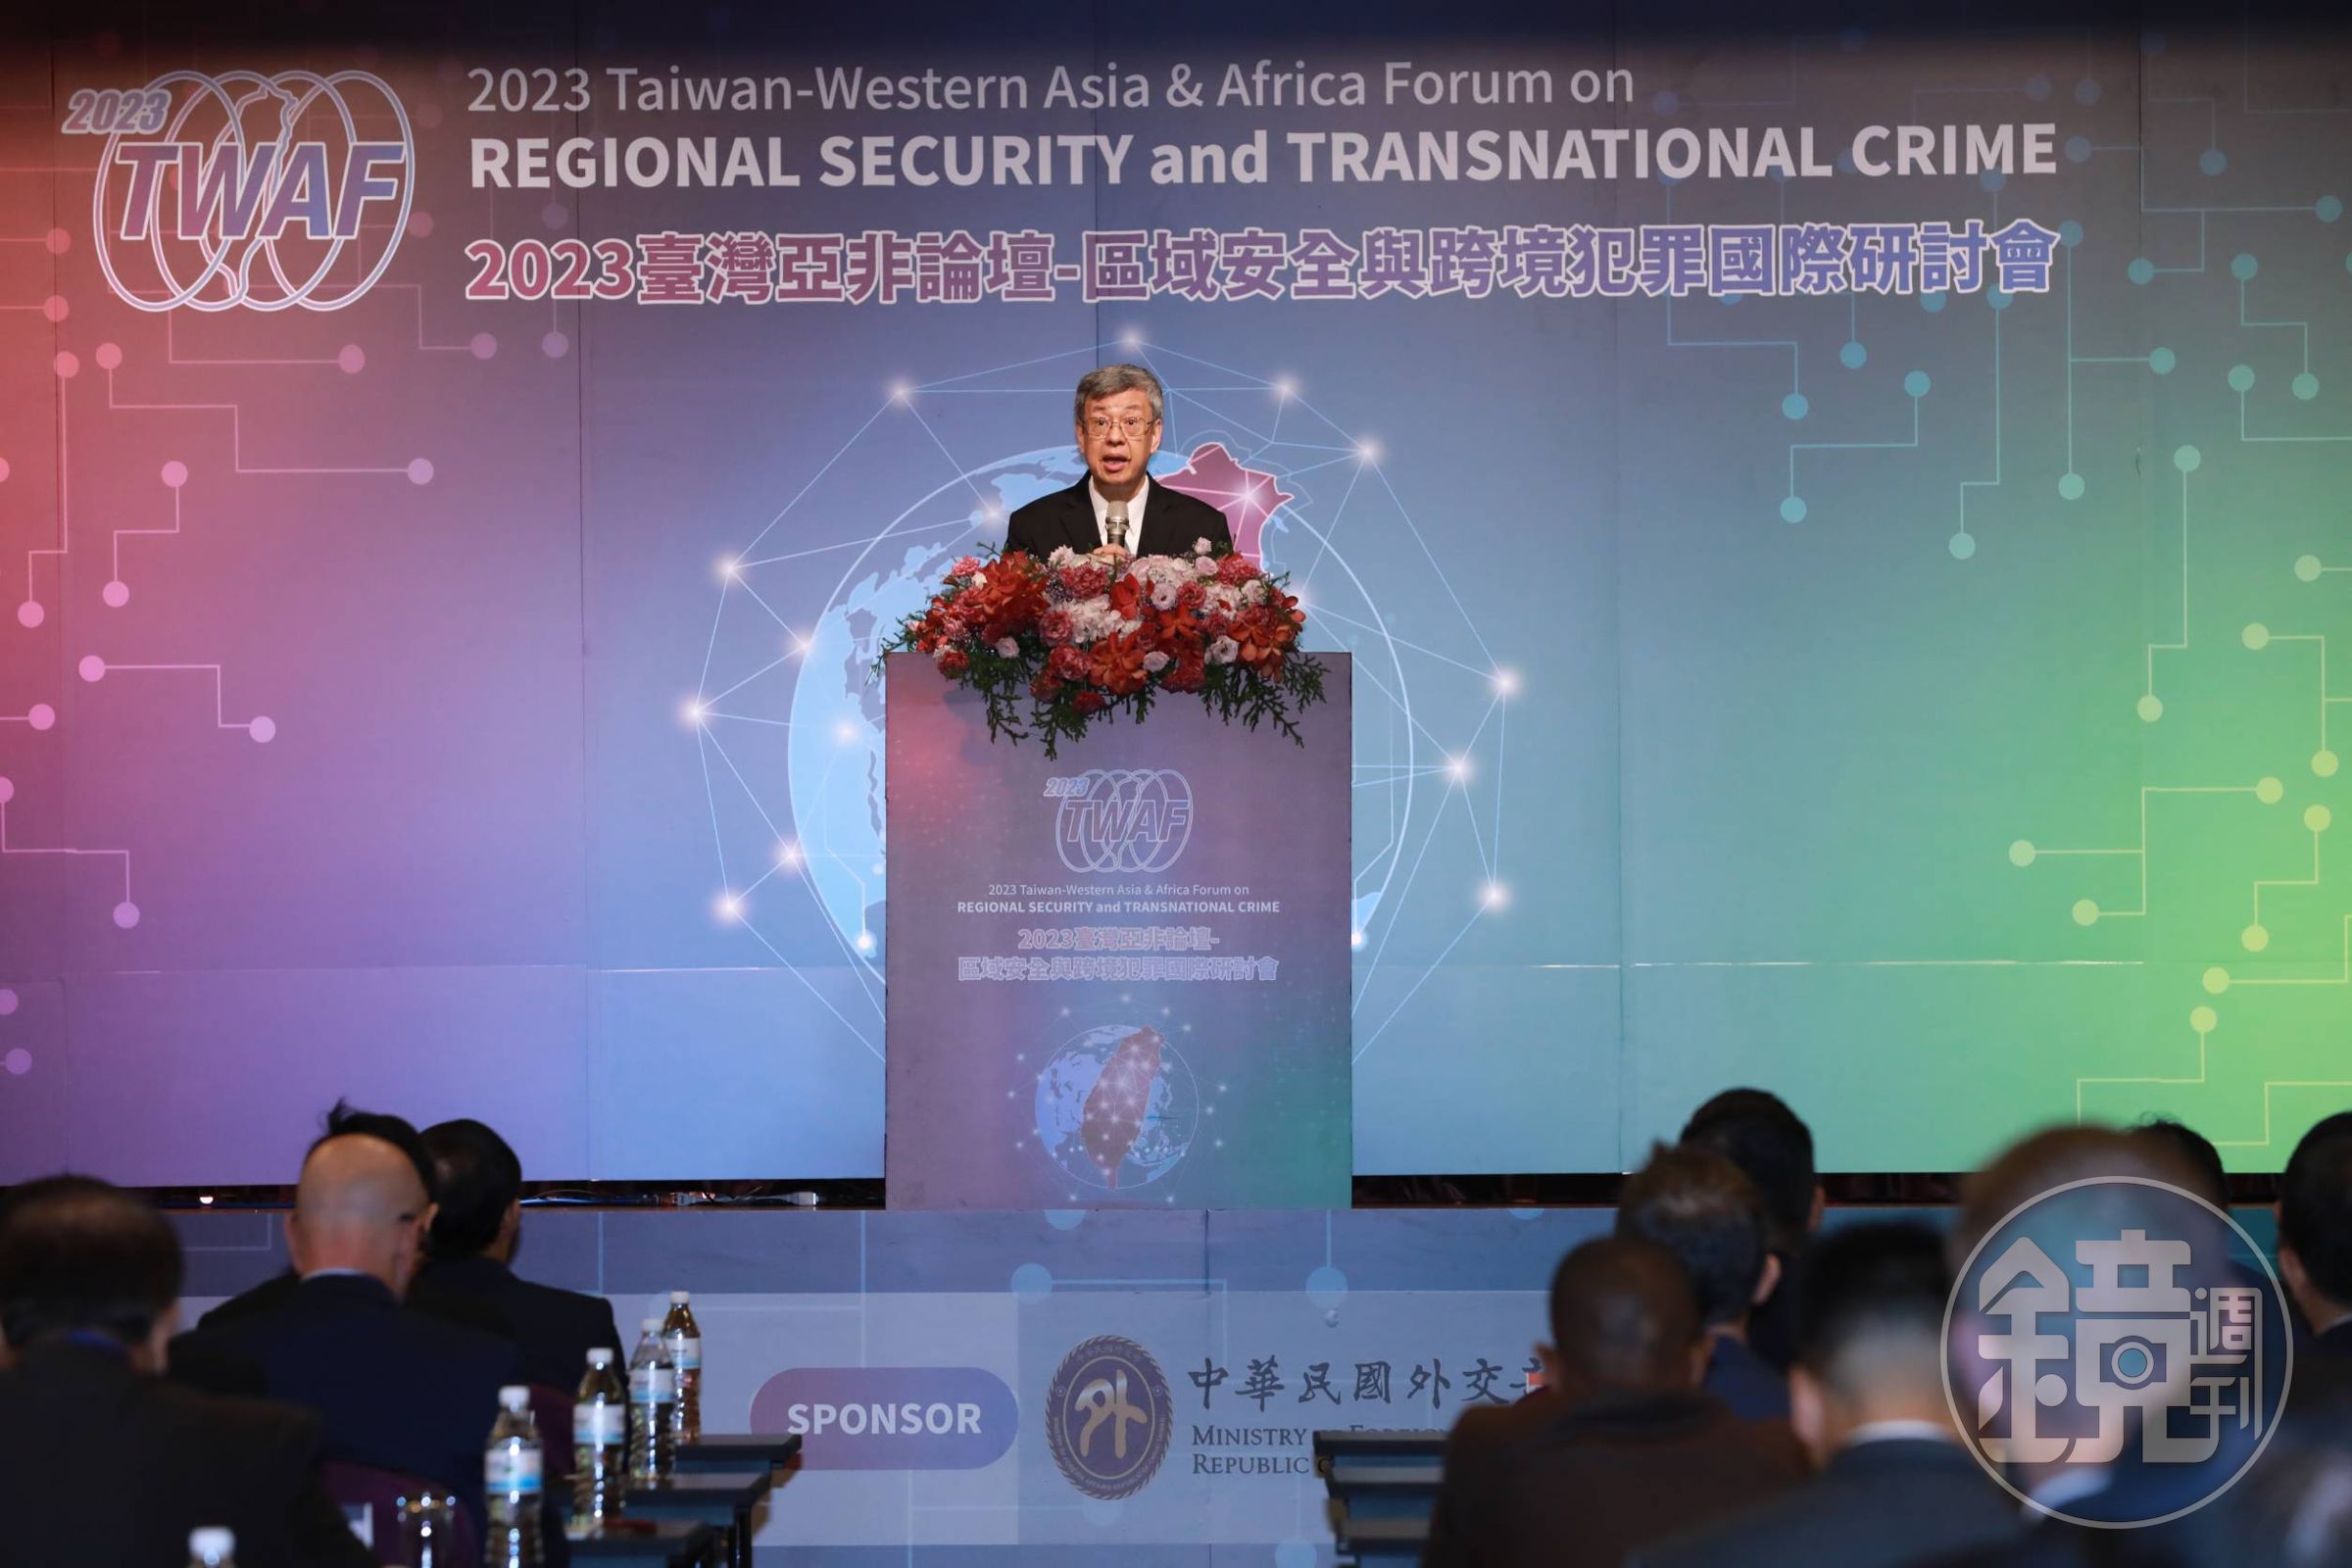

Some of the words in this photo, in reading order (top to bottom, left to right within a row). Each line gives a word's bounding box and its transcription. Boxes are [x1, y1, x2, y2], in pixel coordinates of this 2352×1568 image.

[467, 67, 592, 113] 2023
[607, 65, 1028, 111] Taiwan-Western
[1044, 61, 1150, 109] Asia
[1165, 63, 1203, 108] &
[1216, 59, 1366, 106] Africa
[1385, 61, 1553, 105] Forum
[1570, 69, 1634, 103] on
[63, 89, 171, 134] 2023
[470, 136, 801, 188] REGIONAL
[819, 133, 1134, 186] SECURITY
[1151, 129, 1268, 183] and
[1286, 126, 1833, 182] TRANSNATIONAL
[1852, 122, 2057, 176] CRIME
[115, 141, 407, 240] TWAF
[464, 219, 2060, 305] 2023臺灣亞非論壇-區域安全與跨境犯罪國際研討會
[1043, 776, 1090, 797] 2023
[1066, 800, 1193, 843] TWAF
[957, 902, 1026, 913] REGIONAL
[1029, 902, 1093, 913] SECURITY
[1096, 902, 1121, 912] and
[1124, 902, 1235, 912] TRANSNATIONAL
[1238, 902, 1280, 912] CRIME
[988, 884, 1016, 896] 2023
[1020, 884, 1114, 896] Taiwan-Western
[1117, 884, 1142, 895] Asia
[1145, 884, 1153, 895] &
[1156, 884, 1190, 895] Africa
[1193, 884, 1232, 895] Forum
[1234, 886, 1250, 895] on
[787, 1402, 982, 1435] SPONSOR
[1192, 1425, 1307, 1446] MINISTRY
[1193, 1453, 1310, 1475] REPUBLIC
